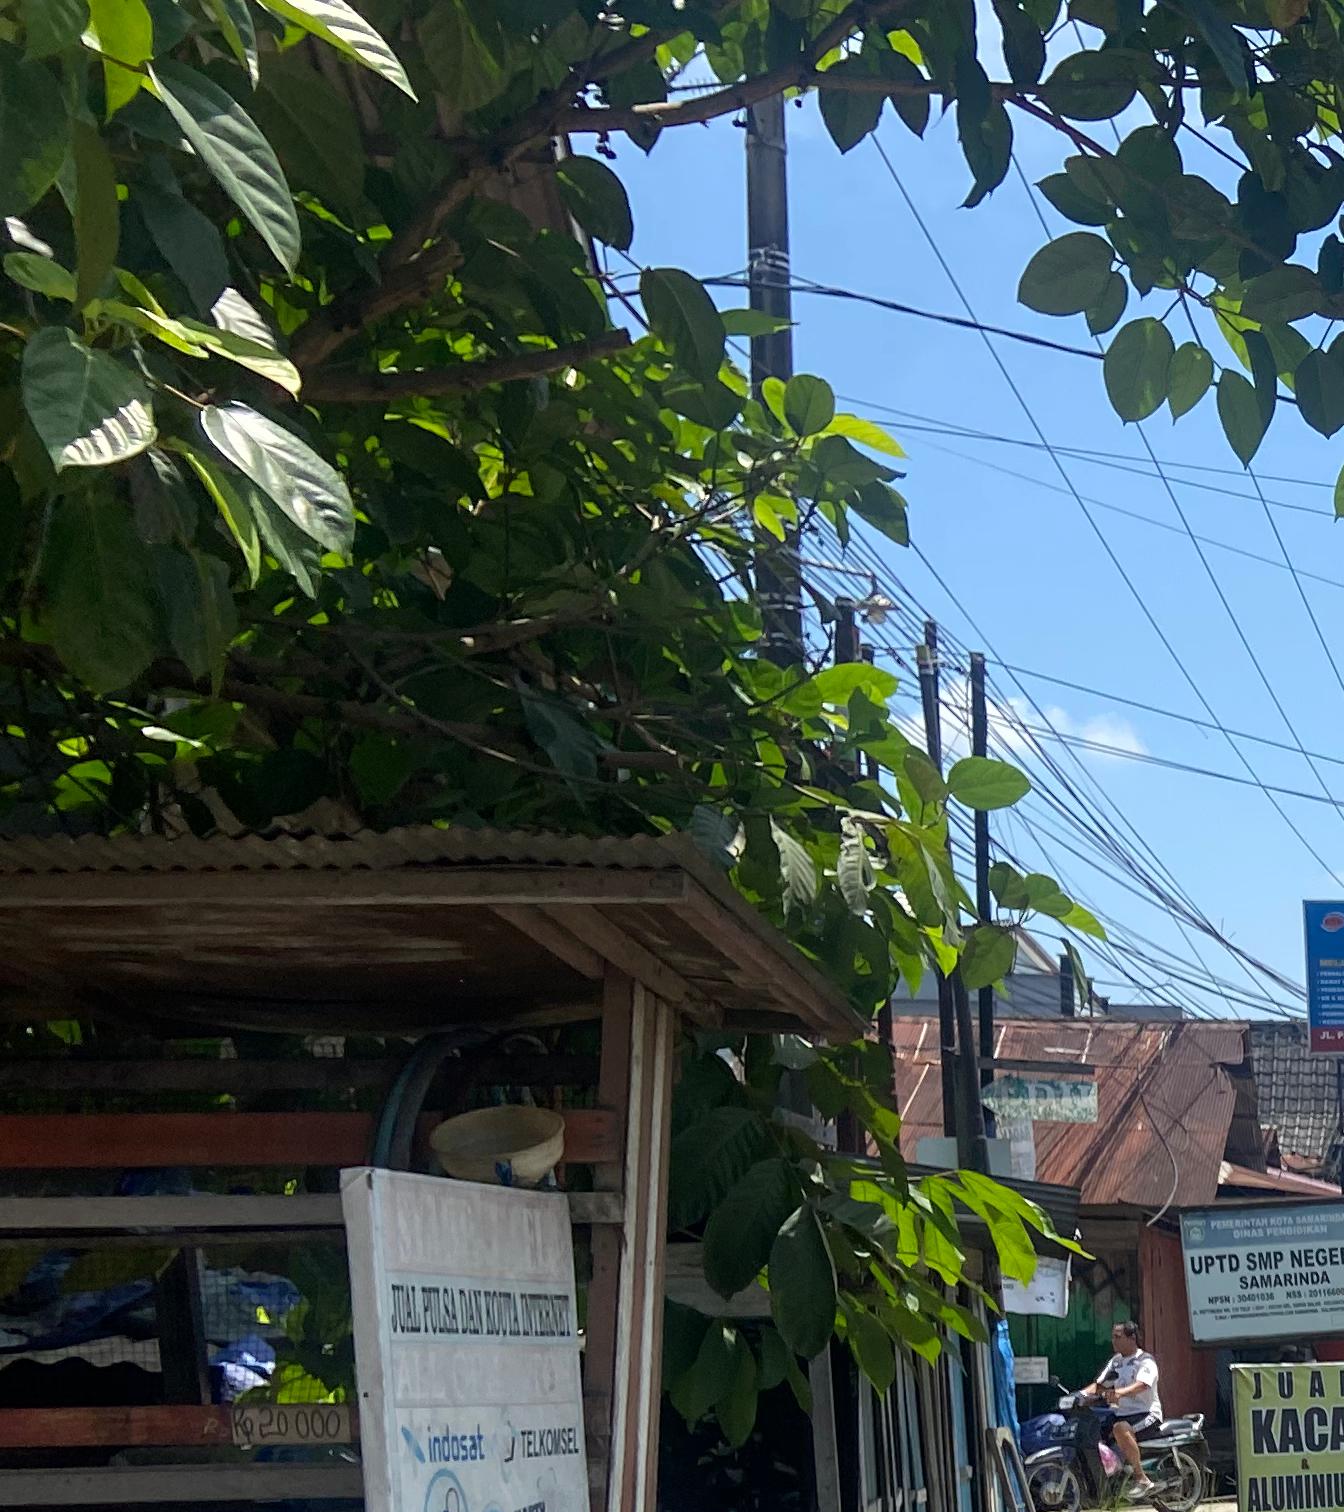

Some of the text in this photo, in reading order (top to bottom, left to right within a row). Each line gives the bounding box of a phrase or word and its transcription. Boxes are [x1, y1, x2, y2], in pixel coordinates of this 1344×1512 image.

[1211, 1217, 1268, 1230] PEMERINTAH
[1269, 1216, 1294, 1226] KOTA
[1233, 1225, 1328, 1239] DINAS PENDIDIKAN
[1190, 1253, 1240, 1275] UPTD
[1246, 1250, 1284, 1271] SMP
[1239, 1271, 1331, 1290] SAMARINDA
[391, 1283, 421, 1334] JUAL
[421, 1285, 459, 1335] PULSA
[459, 1288, 483, 1336] DAN
[520, 1293, 571, 1337] INTERNET
[1208, 1295, 1231, 1305] NPSN
[428, 1423, 485, 1462] indosat
[520, 1426, 580, 1459] TELKOMSEL
